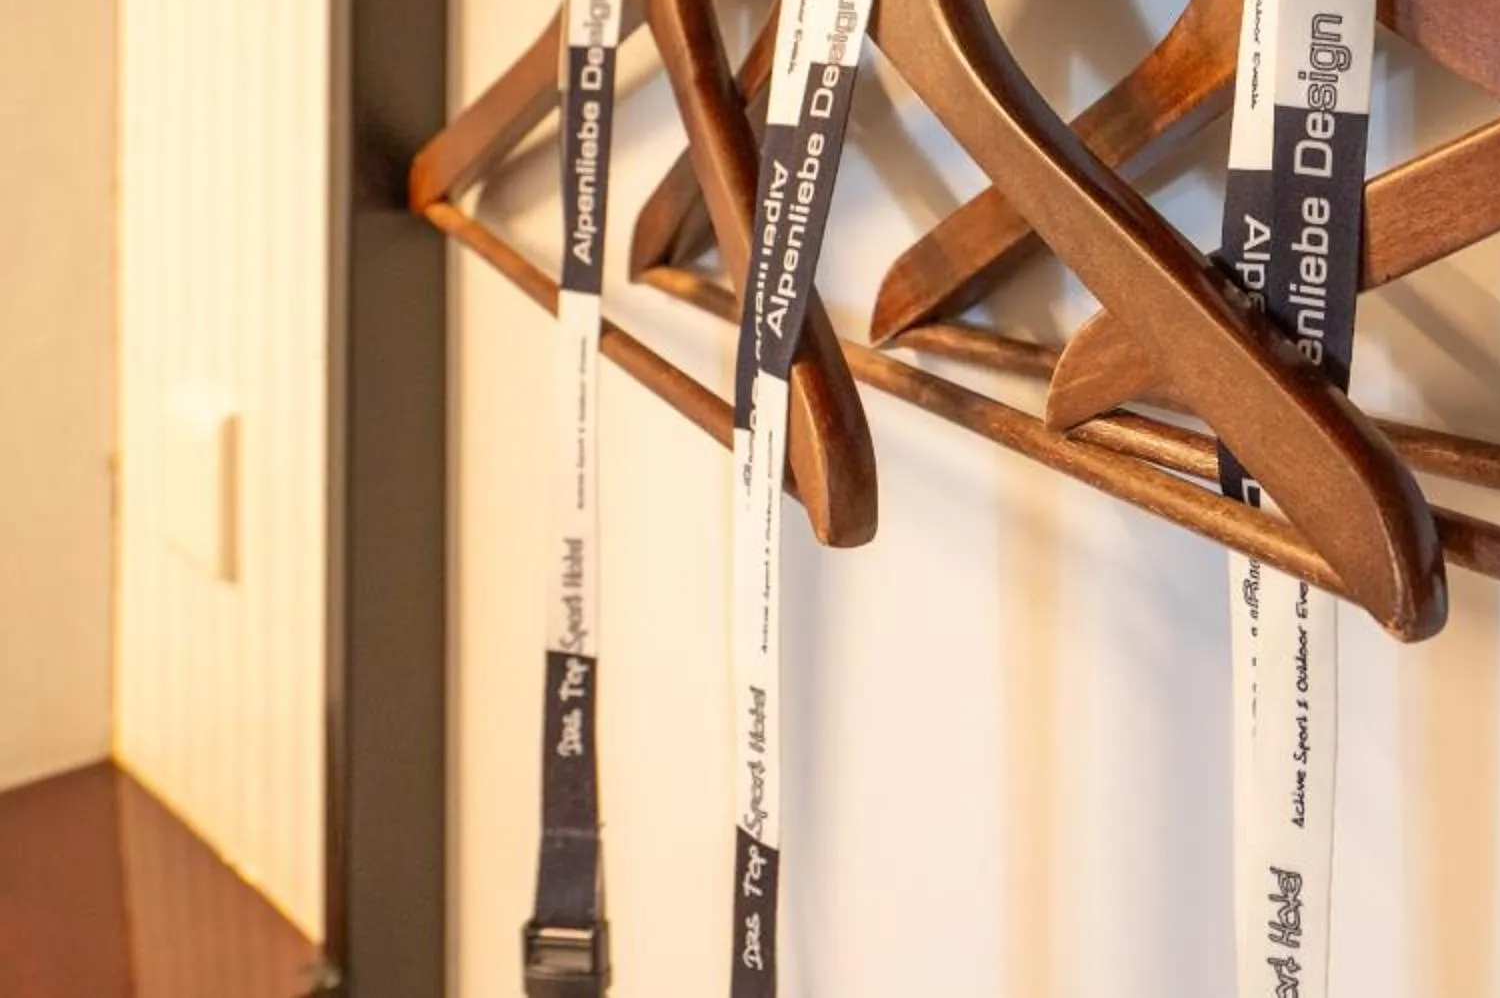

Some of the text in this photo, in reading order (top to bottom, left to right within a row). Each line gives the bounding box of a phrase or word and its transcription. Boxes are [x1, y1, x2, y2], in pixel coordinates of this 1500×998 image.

[1293, 13, 1352, 178] Design
[572, 99, 600, 265] Alpenliebe
[766, 132, 825, 340] Alpenliebe
[1288, 196, 1331, 366] enliebe
[557, 657, 590, 702] Top
[1296, 622, 1312, 694] Outdoor
[747, 684, 766, 754] Hotel
[1292, 713, 1311, 765] Sport
[743, 759, 769, 842] Sport
[1291, 769, 1307, 830] Active
[743, 843, 768, 898] Top
[1267, 866, 1303, 948] Hotel
